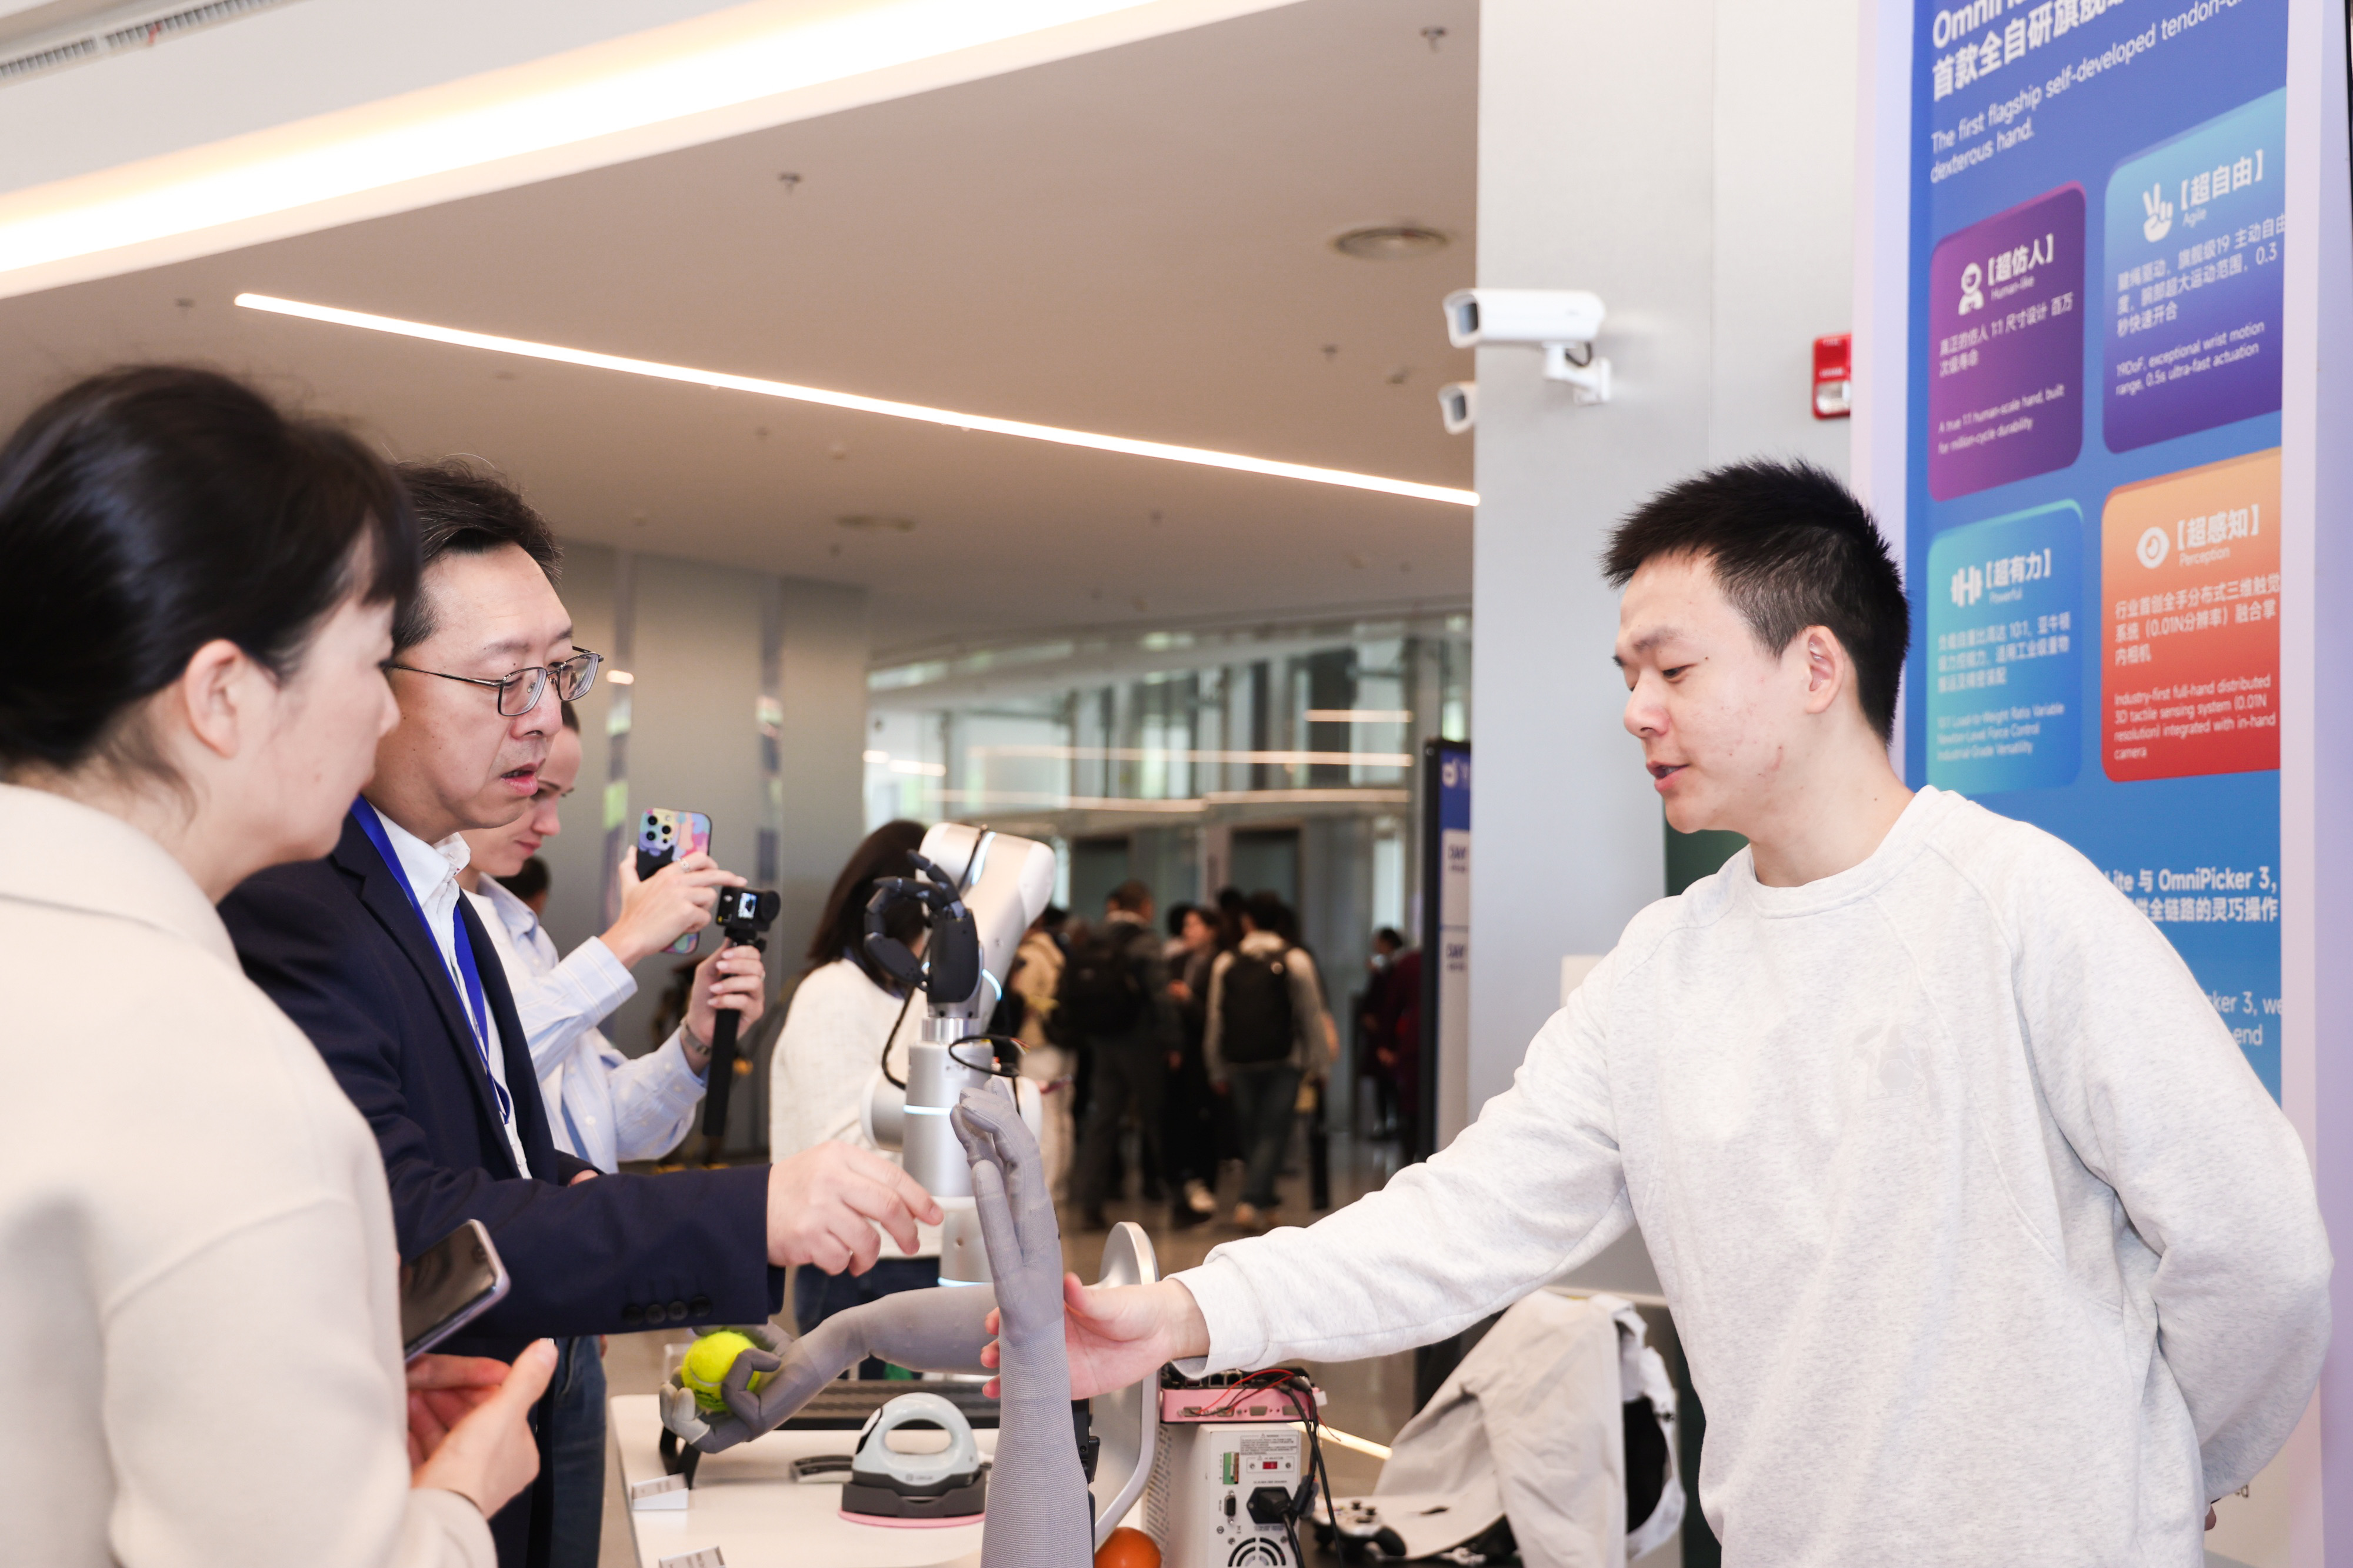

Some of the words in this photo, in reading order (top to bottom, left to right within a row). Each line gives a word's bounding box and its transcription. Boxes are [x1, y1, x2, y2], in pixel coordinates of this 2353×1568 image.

[1931, 129, 1956, 154] The
[1958, 111, 1985, 141] first
[1988, 85, 2042, 126] flagship
[2046, 22, 2156, 98] self-developed
[2161, 0, 2242, 40] tendon-
[1930, 140, 1994, 184] dexterous
[2182, 207, 2207, 228] Agile
[2148, 339, 2201, 368] exceptional
[2229, 321, 2264, 342] motion
[2168, 356, 2211, 381] ultra-fast
[2212, 342, 2259, 367] actuation
[2179, 547, 2231, 567] Perception
[2217, 673, 2271, 694] distributed
[2159, 703, 2195, 720] sensing
[2197, 700, 2232, 717] system
[2162, 719, 2212, 740] integrated
[2212, 716, 2235, 732] with
[2237, 711, 2276, 729] in-hand
[2114, 746, 2147, 761] camera
[2138, 869, 2154, 893] 与
[2158, 866, 2254, 892] OmniPicker
[2258, 865, 2278, 894] 3,
[2130, 896, 2278, 922] 供全链路的灵巧操作
[2242, 991, 2258, 1017] 3,
